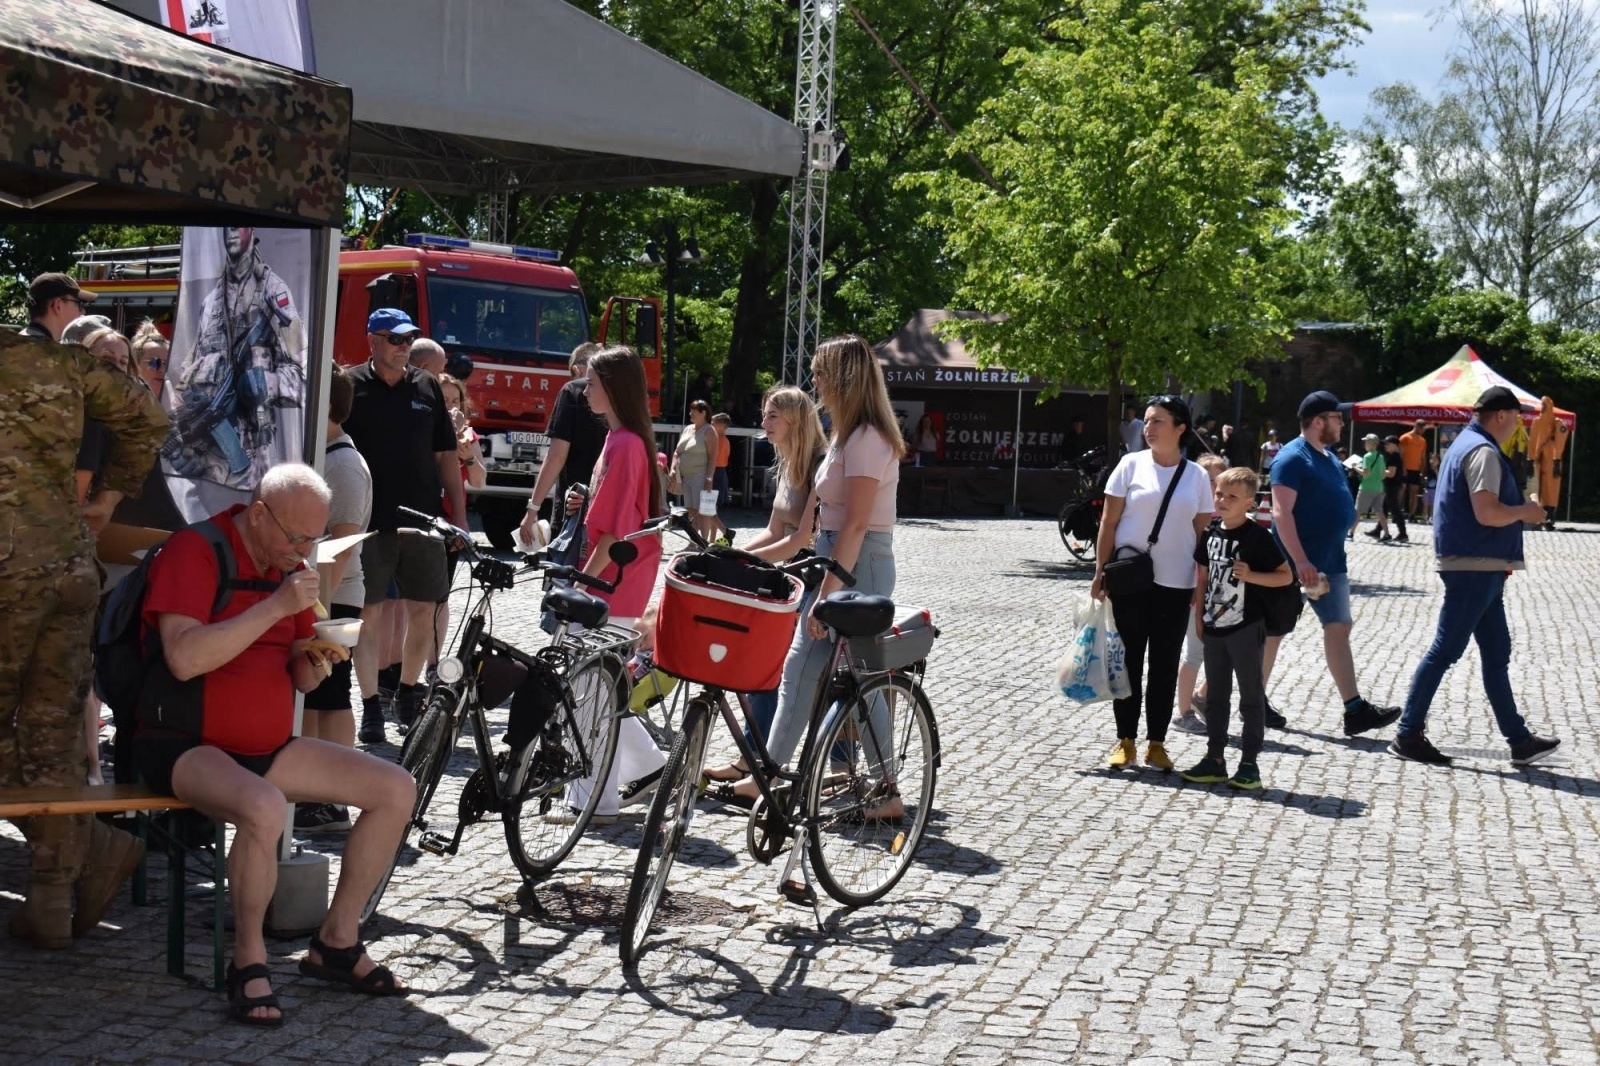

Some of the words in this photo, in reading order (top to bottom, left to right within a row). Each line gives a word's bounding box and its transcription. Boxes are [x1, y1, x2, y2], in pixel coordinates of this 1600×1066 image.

[886, 368, 925, 382] STAŃ
[486, 373, 549, 391] STAR
[946, 410, 986, 422] ZOSTAŃ
[1444, 409, 1472, 419] STOPN
[512, 432, 524, 443] UG
[525, 433, 550, 444] 01077
[945, 426, 1065, 447] ŻOŁNIERZEM
